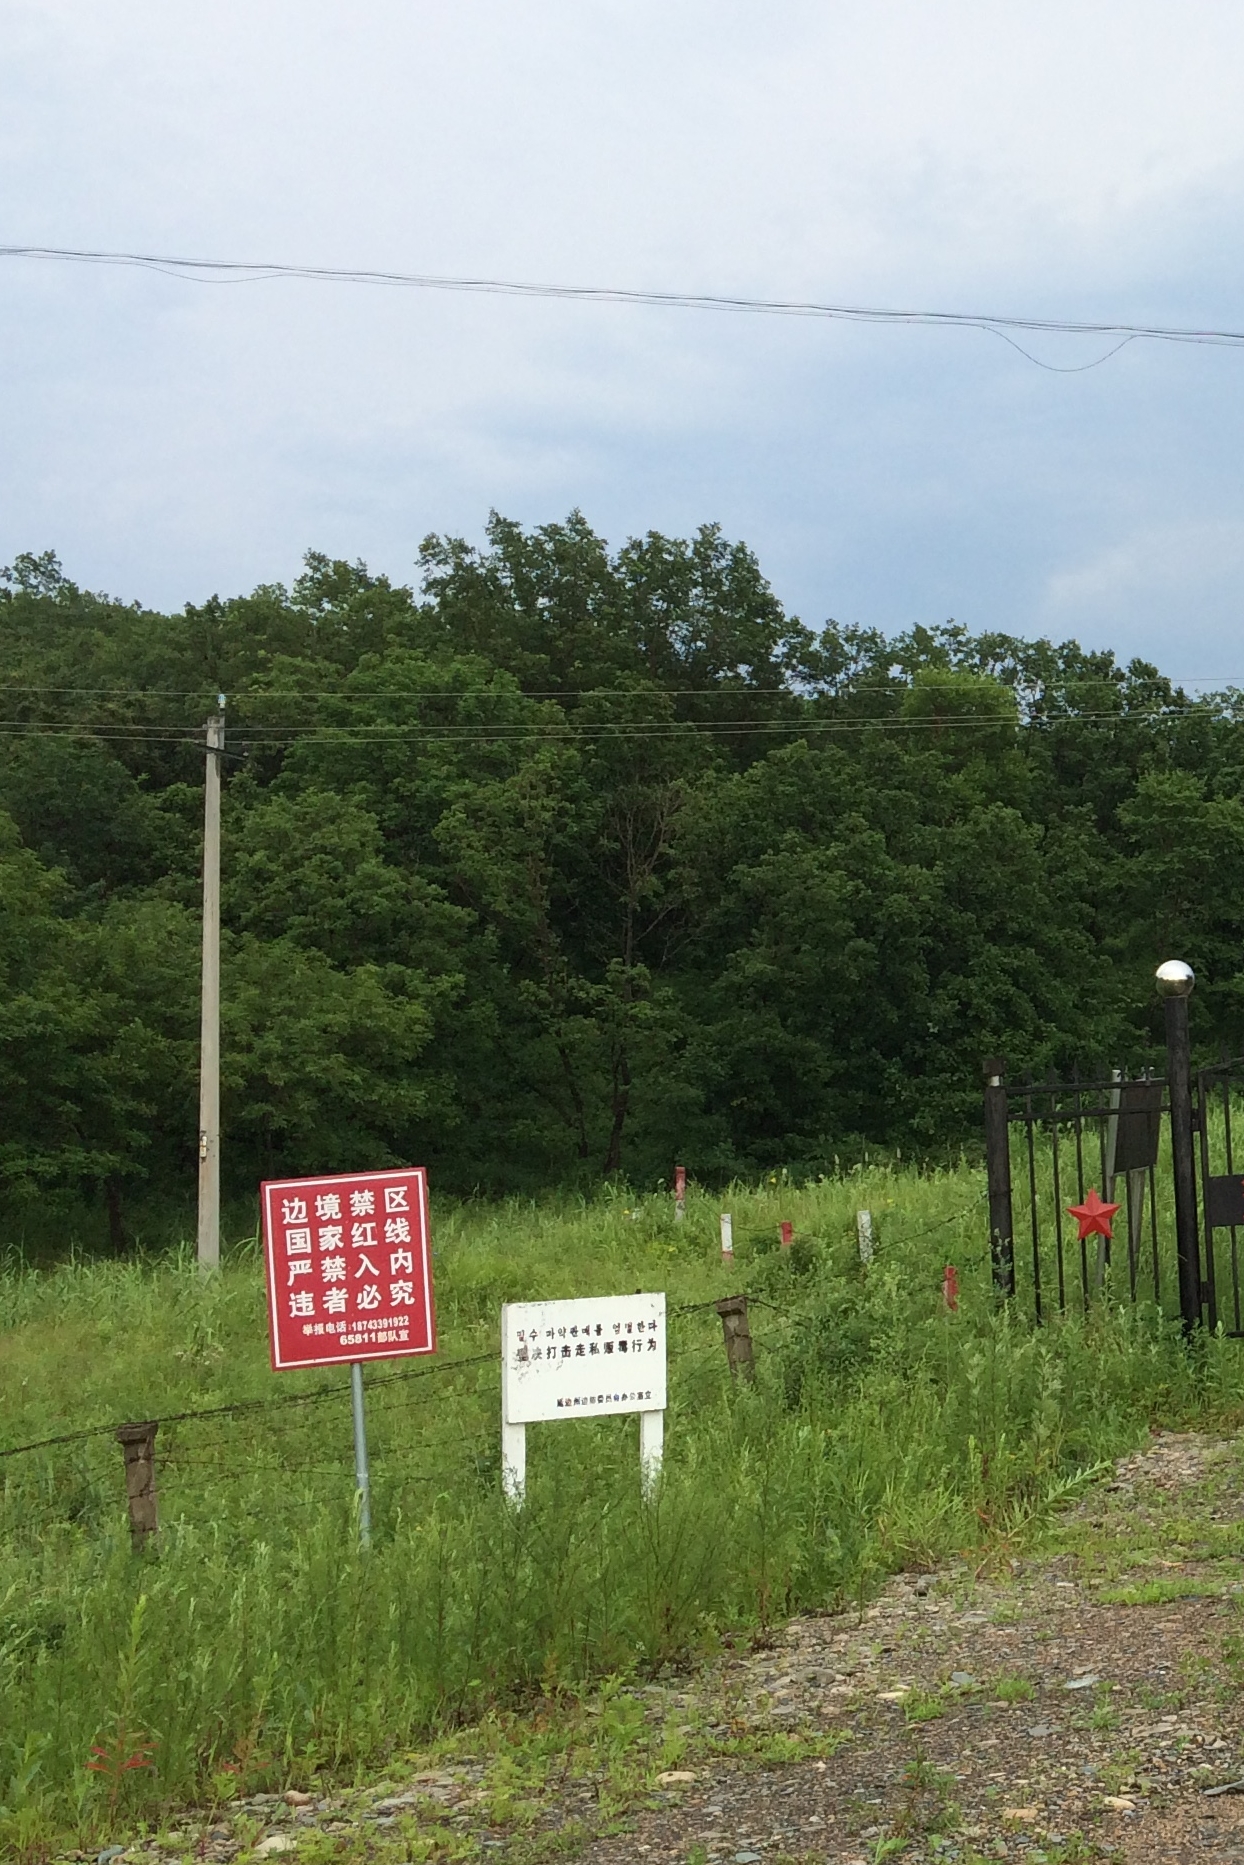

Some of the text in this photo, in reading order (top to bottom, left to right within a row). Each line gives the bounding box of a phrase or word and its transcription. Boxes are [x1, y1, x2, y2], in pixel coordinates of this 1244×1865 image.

[281, 1186, 409, 1224] 边境禁区
[286, 1218, 411, 1255] 国家红线
[287, 1249, 412, 1286] 严禁入内
[289, 1280, 415, 1317] 违者必究
[340, 1329, 409, 1346] 65811部队宣
